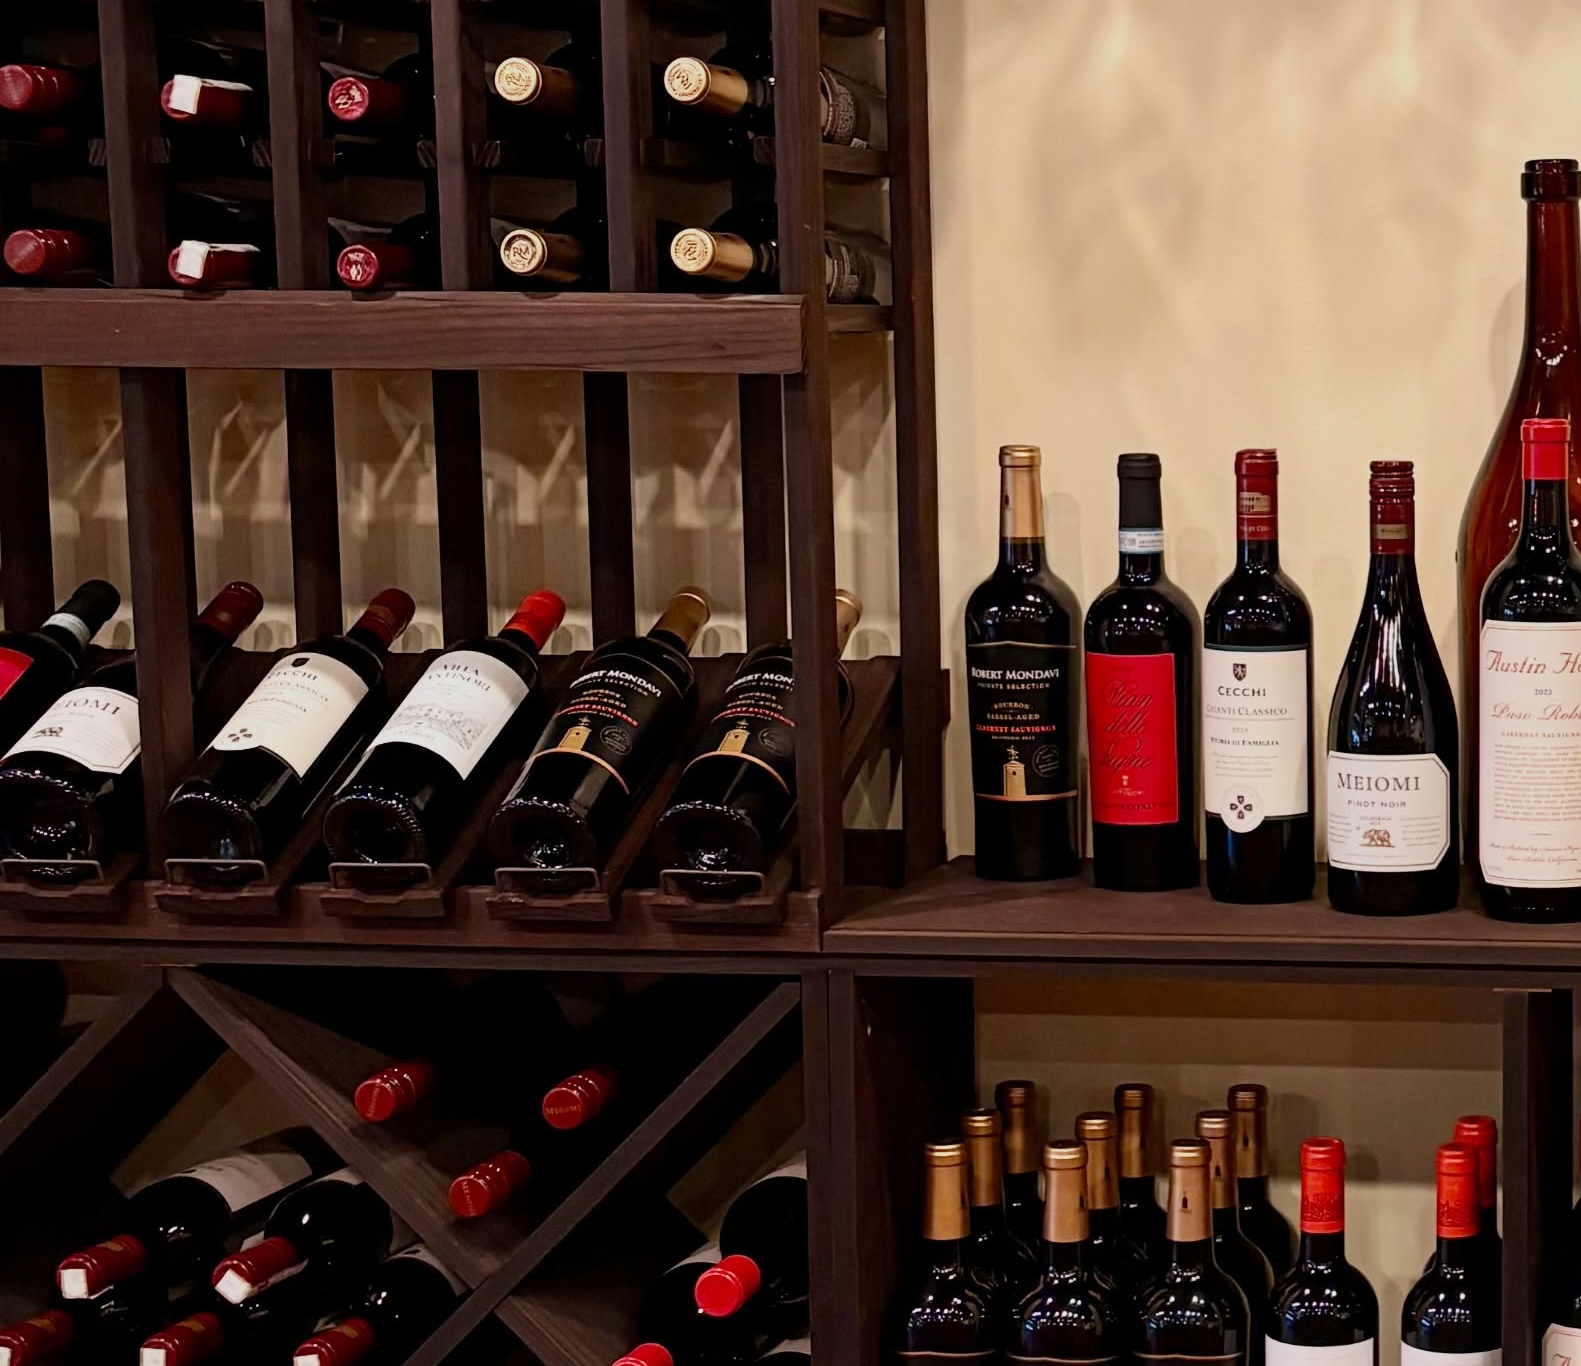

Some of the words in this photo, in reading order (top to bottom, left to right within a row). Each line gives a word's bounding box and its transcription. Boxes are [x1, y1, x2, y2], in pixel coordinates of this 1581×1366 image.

[1486, 649, 1547, 674] Austin
[762, 672, 795, 686] MON
[971, 667, 1003, 680] ROBERT
[1005, 668, 1060, 680] MONDAVI
[606, 669, 662, 697] MONDAVI
[1006, 682, 1050, 690] SELECTION
[1217, 685, 1267, 697] CECCHI
[1237, 706, 1288, 716] CLASSICO
[1491, 700, 1532, 720] Paso
[1010, 724, 1057, 733] SAUVIGNON
[1337, 772, 1421, 792] MEIOMI
[1347, 799, 1376, 808] PINOT
[1380, 801, 1407, 809] NOIR
